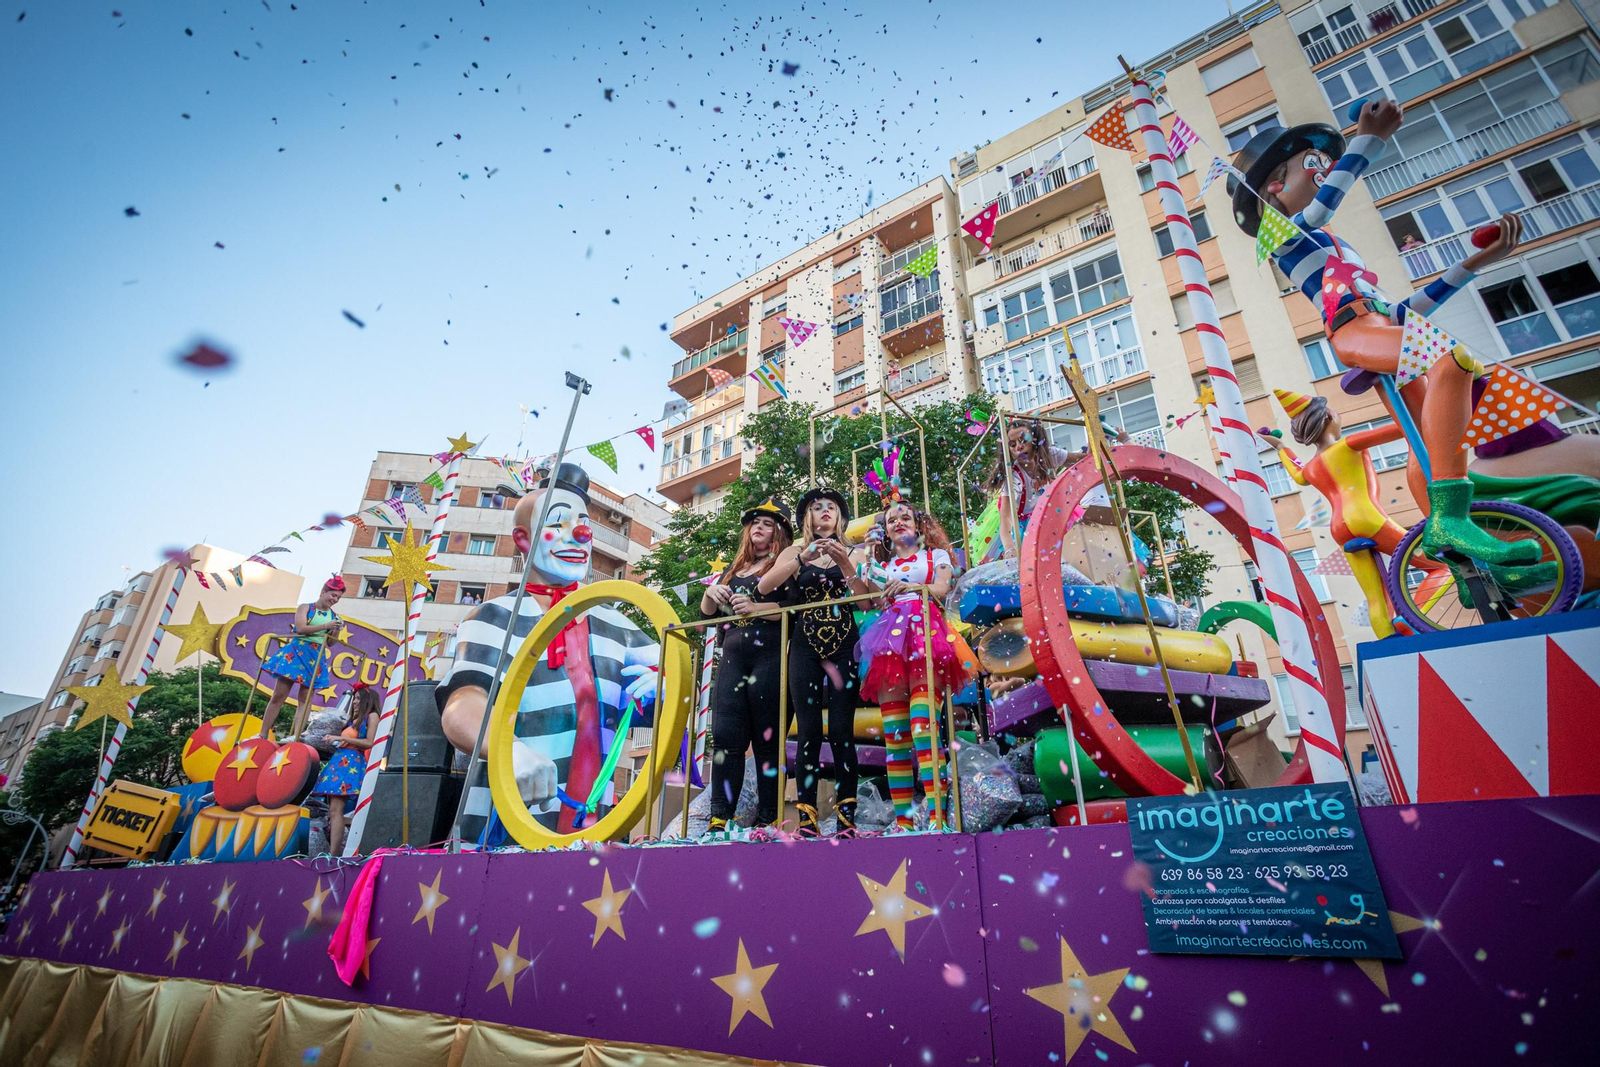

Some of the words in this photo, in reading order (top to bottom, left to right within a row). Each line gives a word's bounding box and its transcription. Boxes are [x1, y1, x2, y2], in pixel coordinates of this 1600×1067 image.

[255, 632, 403, 688] CCU
[100, 804, 155, 833] TICKET
[1137, 788, 1346, 862] imaginarte
[1247, 825, 1350, 842] creaciones
[1229, 844, 1354, 856] imaginartecreaciones@gmail.com
[1161, 869, 1183, 881] 639
[1187, 868, 1203, 880] 86
[1206, 867, 1223, 880] 58
[1226, 867, 1244, 879] 23
[1254, 866, 1280, 879] 625
[1283, 865, 1302, 878] 93
[1305, 864, 1325, 878] 58
[1328, 864, 1348, 877] 23
[1189, 887, 1195, 895] &
[1151, 897, 1184, 905] Carrozas
[1204, 897, 1247, 905] cabalgatas
[1248, 896, 1254, 904] &
[1255, 896, 1286, 904] desfiles
[1153, 907, 1194, 915] Decoración
[1196, 907, 1206, 915] de
[1206, 907, 1229, 915] bares
[1236, 907, 1265, 915] locales
[1266, 907, 1316, 915] comerciales
[1155, 917, 1206, 925] Ambientación
[1218, 918, 1251, 926] parques
[1252, 917, 1292, 926] temáticos
[1175, 934, 1367, 949] imaginartecreaciones.com
